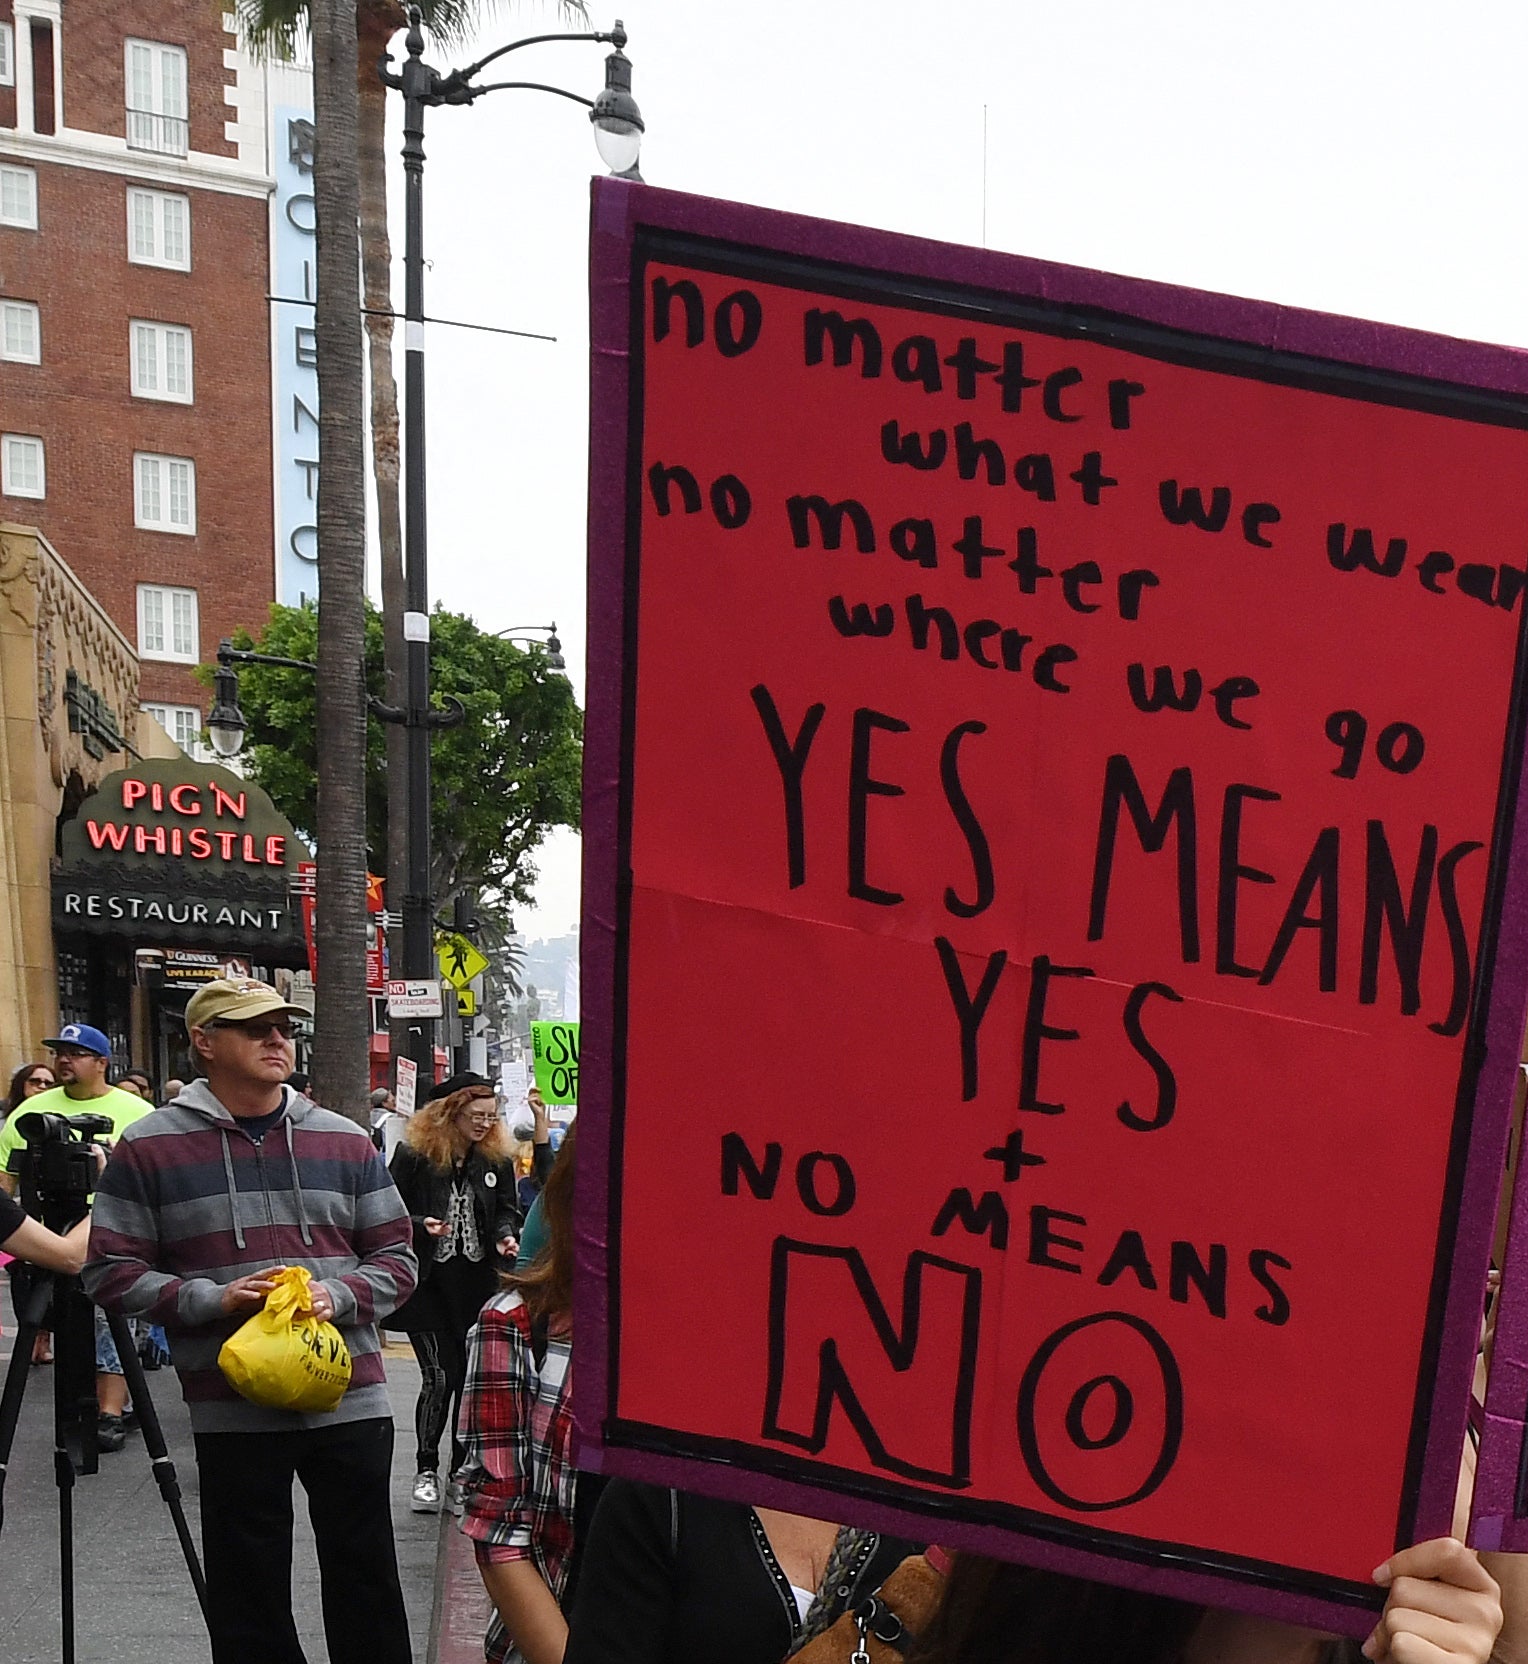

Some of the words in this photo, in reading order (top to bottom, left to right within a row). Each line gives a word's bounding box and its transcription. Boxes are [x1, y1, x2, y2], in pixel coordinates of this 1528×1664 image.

[652, 276, 763, 358] no
[804, 308, 1145, 430] matter
[648, 461, 752, 529] no
[786, 493, 1159, 620] matter
[881, 420, 1118, 505] what
[1159, 480, 1281, 548] we
[1327, 521, 1528, 612] wear
[828, 594, 1078, 693] where
[1127, 663, 1260, 730] we
[1326, 710, 1425, 779] go
[65, 893, 282, 930] RESTAURANT
[86, 819, 286, 866] WHISTLE
[751, 684, 995, 918] YES
[1088, 753, 1486, 1036] MEANS
[388, 983, 405, 994] NO
[934, 936, 1184, 1132] YES
[721, 1132, 856, 1217] NO
[930, 1188, 1291, 1327] MEANS
[984, 1129, 1046, 1182] +
[761, 1235, 1184, 1512] NO
